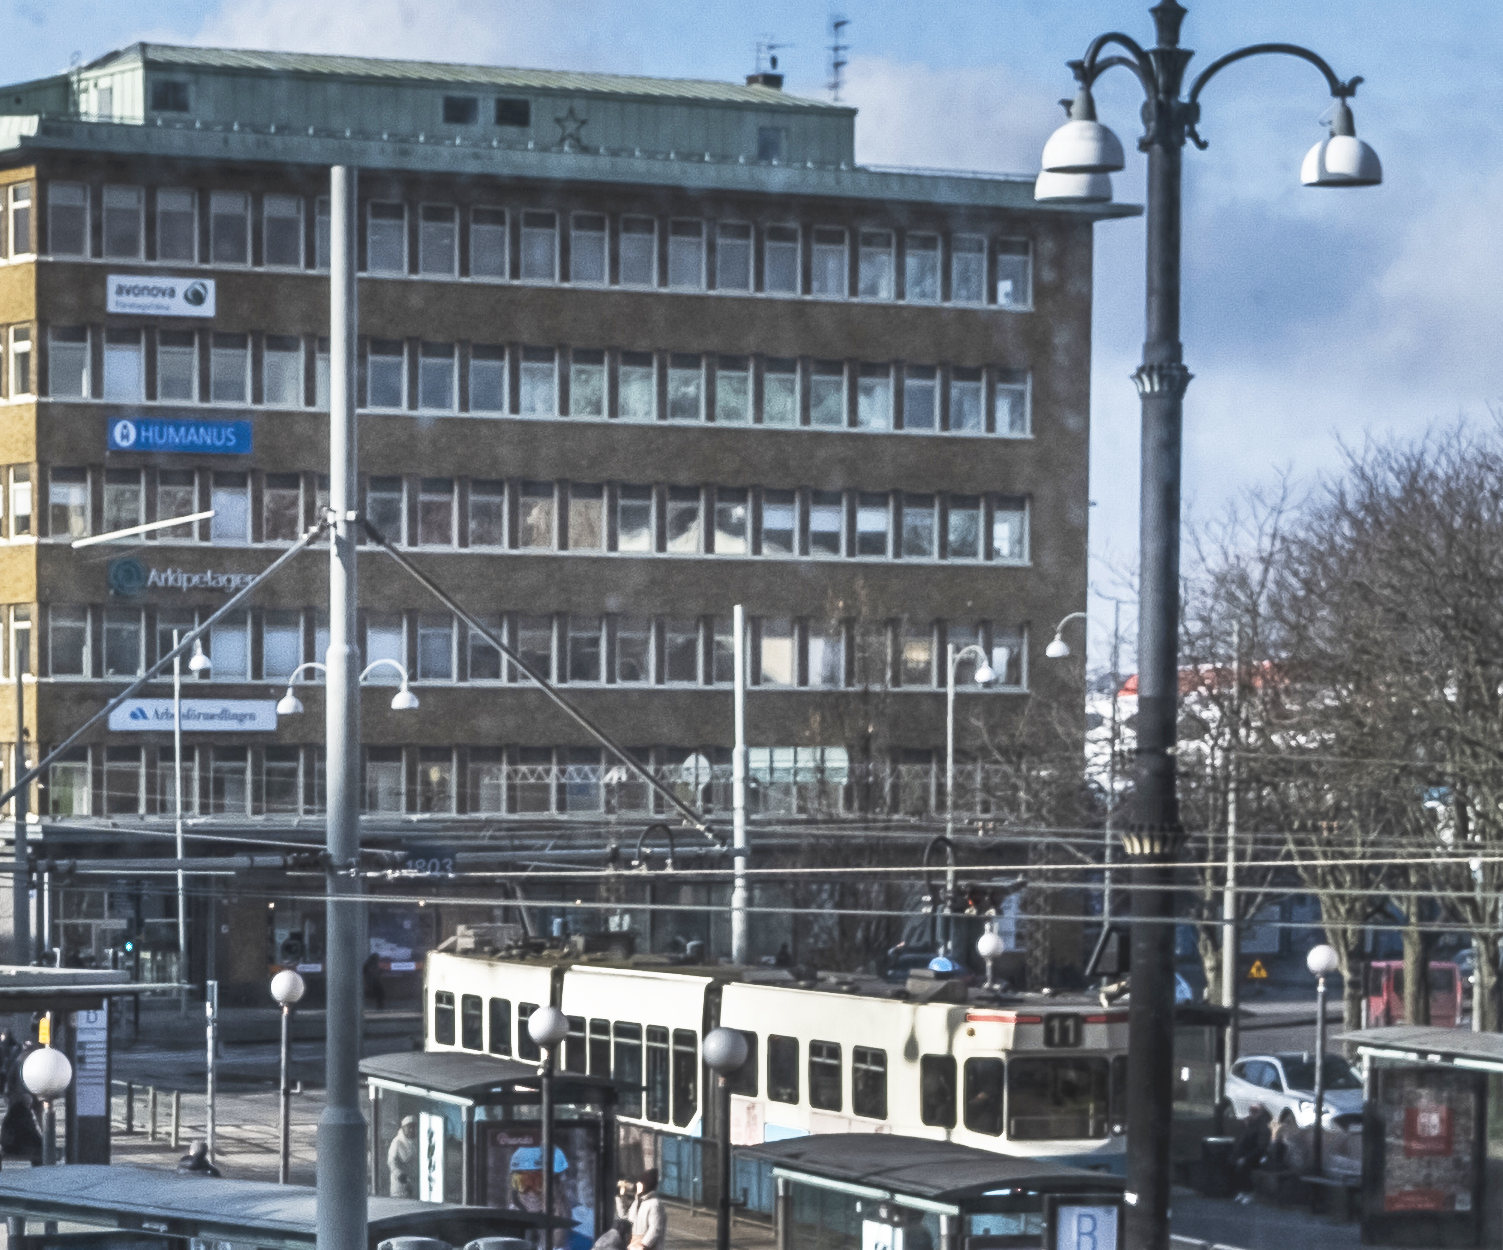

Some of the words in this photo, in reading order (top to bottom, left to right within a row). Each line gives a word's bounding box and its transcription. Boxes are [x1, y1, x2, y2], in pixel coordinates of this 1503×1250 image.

[115, 283, 176, 299] avonova
[140, 425, 237, 446] HUMANUS
[1050, 1018, 1074, 1043] 11
